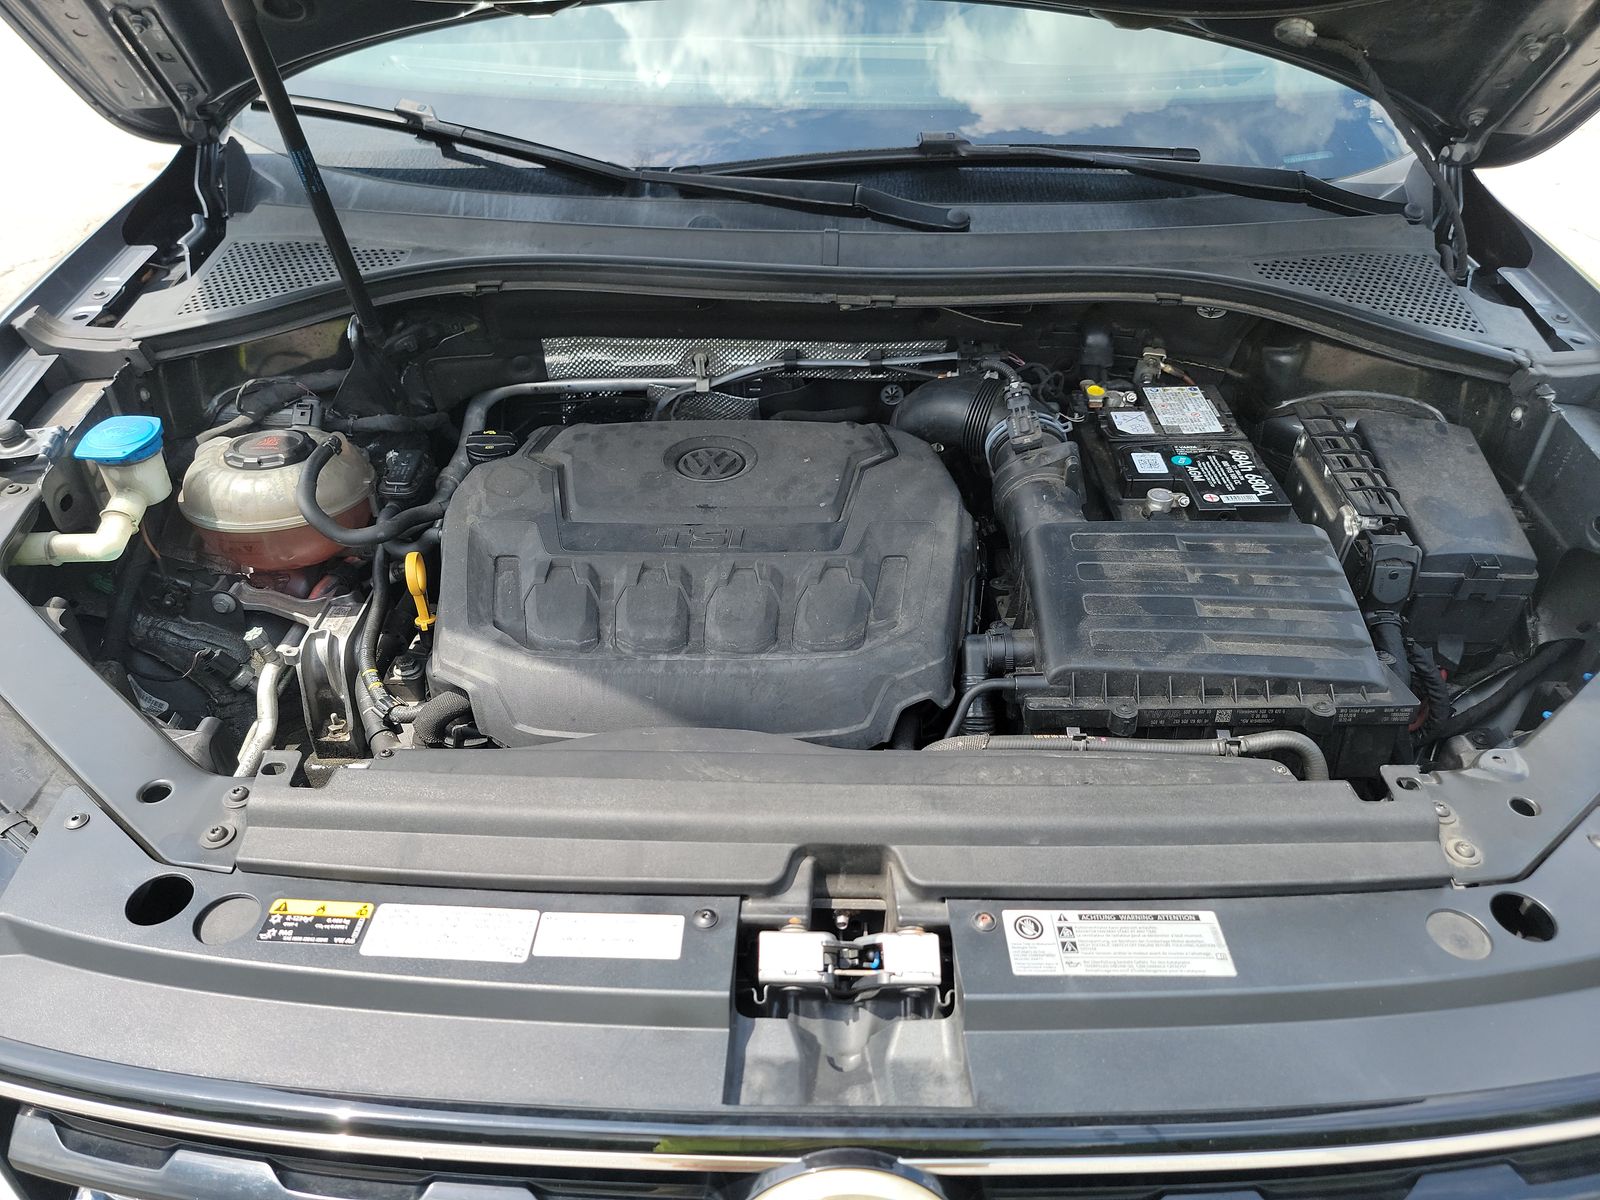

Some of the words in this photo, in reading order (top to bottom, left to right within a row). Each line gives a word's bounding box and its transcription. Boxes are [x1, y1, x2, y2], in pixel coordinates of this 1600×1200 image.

[1185, 466, 1206, 482] AGM
[1228, 449, 1256, 472] 68Ah
[1244, 473, 1274, 497] 680A
[656, 527, 747, 549] TSI
